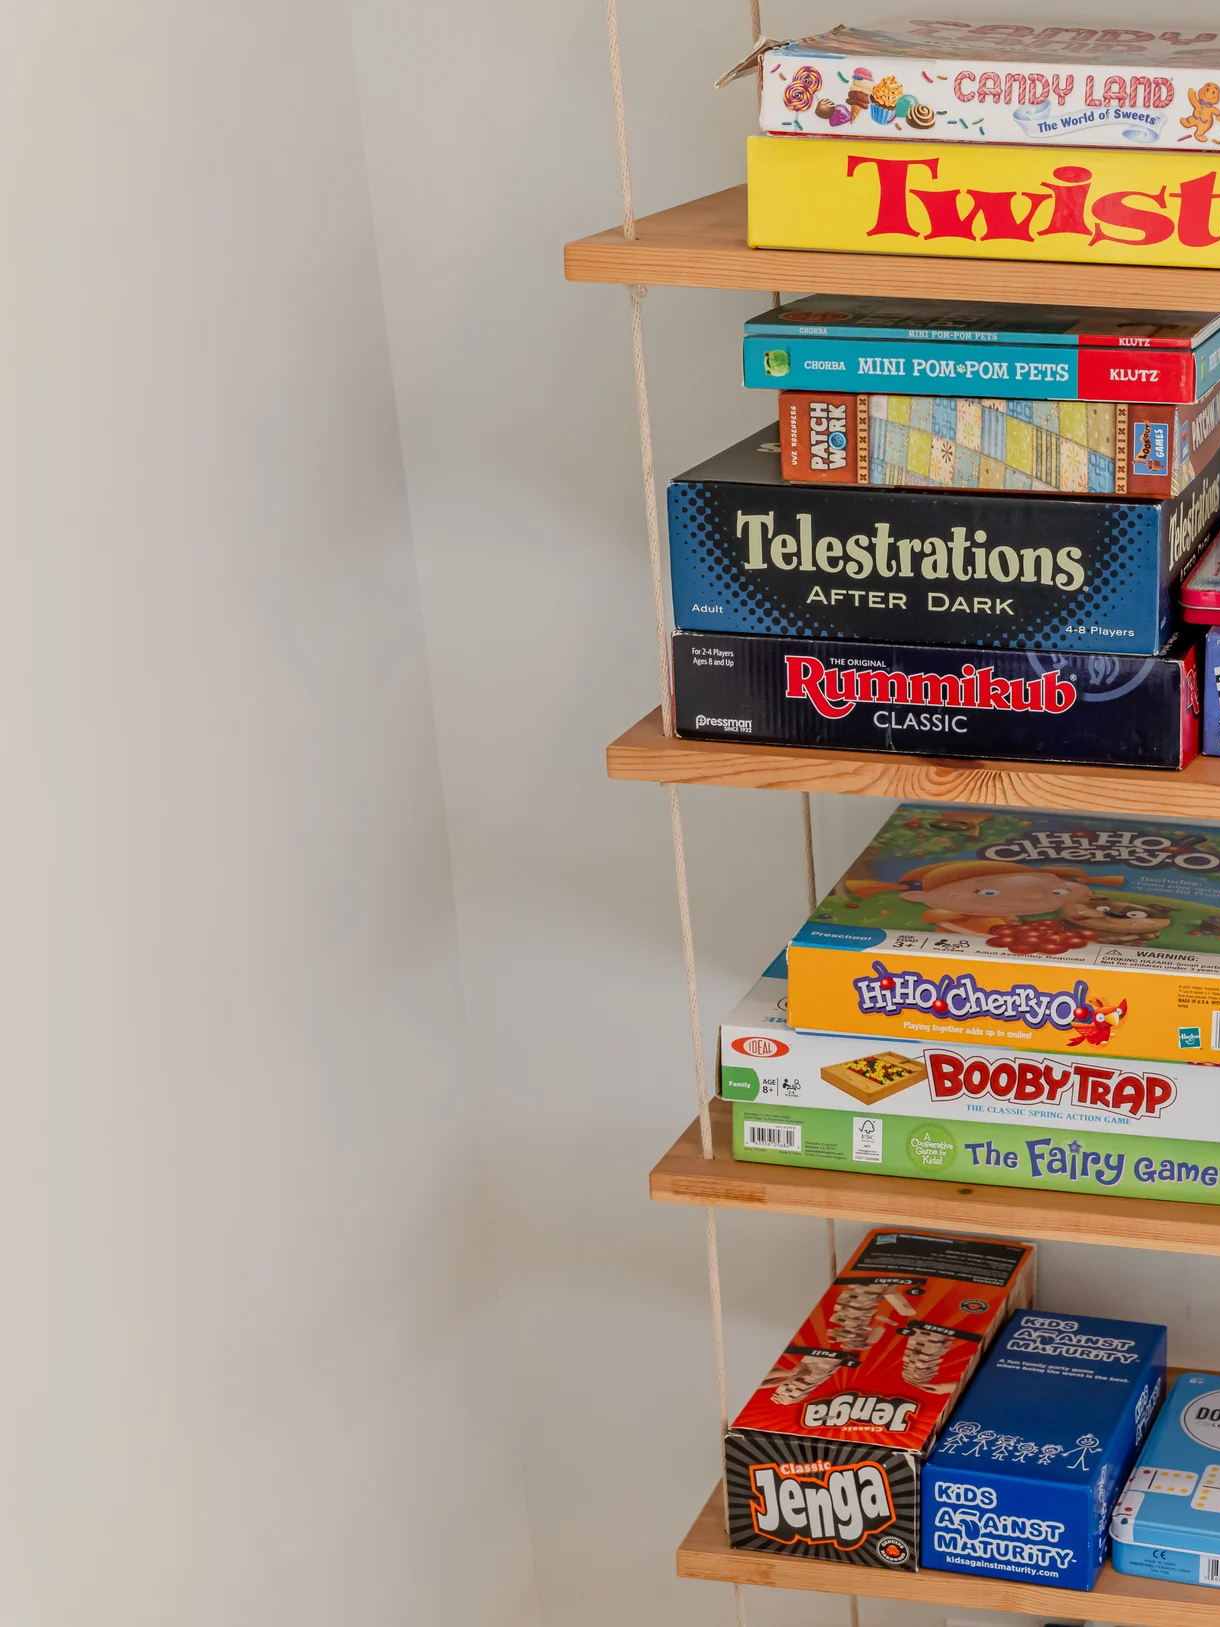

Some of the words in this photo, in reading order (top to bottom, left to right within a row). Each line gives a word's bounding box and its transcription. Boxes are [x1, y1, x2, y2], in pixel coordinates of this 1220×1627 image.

[909, 20, 1217, 45] CANDY
[954, 71, 1074, 106] CANDY
[1085, 75, 1174, 108] LAND
[1037, 121, 1058, 134] The
[1060, 110, 1095, 128] World
[1098, 109, 1110, 120] of
[1114, 109, 1156, 125] Sweets
[908, 330, 928, 338] MINI
[932, 331, 972, 340] POM-POM
[975, 332, 998, 340] PETS
[1119, 338, 1150, 347] KLUTZ
[804, 360, 846, 371] CHORBA
[858, 358, 906, 376] MINI
[1015, 362, 1069, 382] PETS
[1110, 368, 1159, 382] KLUTZ
[790, 406, 798, 448] ROSENBERG
[810, 402, 828, 470] PATCH
[828, 404, 846, 470] WORK
[1156, 428, 1164, 458] GAMES
[1168, 473, 1220, 572] Telestrations
[736, 510, 1085, 592] Telestrations
[806, 585, 907, 610] AFTER
[928, 592, 1015, 616] DARK
[692, 604, 724, 614] Adult
[1065, 626, 1086, 635] 4-8
[1090, 626, 1135, 638] Players
[702, 648, 712, 656] 2-4
[713, 649, 734, 658] Players
[693, 658, 708, 666] Ages
[708, 658, 712, 666] 8
[714, 658, 724, 666] and
[830, 658, 845, 666] THE
[847, 658, 887, 668] ORIGINAL
[785, 655, 1077, 720] Rummikub
[873, 710, 968, 733] CLASSIC
[811, 931, 872, 942] Preschool
[1000, 952, 1043, 960] Assembly
[1136, 951, 1199, 962] WARNING:
[903, 1022, 930, 1032] Playing
[932, 1024, 963, 1034] together
[1007, 1030, 1032, 1039] smiles!
[749, 1040, 772, 1055] IDEAL
[729, 1080, 751, 1088] Family
[762, 1086, 774, 1094] 8+
[929, 1054, 1064, 1102] BOOBY
[1072, 1064, 1172, 1116] TRAP
[966, 1104, 984, 1112] THE
[987, 1106, 1025, 1116] CLASSIC
[1028, 1109, 1063, 1120] SPRING
[1066, 1112, 1100, 1122] ACTION
[1104, 1116, 1132, 1126] GAME
[924, 1133, 932, 1141] A
[910, 1138, 954, 1152] Cooperative
[916, 1148, 938, 1156] Game
[922, 1154, 942, 1166] Kids!
[965, 1140, 1018, 1168] The
[1025, 1138, 1126, 1186] Fairy
[1134, 1158, 1219, 1186] Game
[874, 1278, 914, 1286] Crash!
[923, 1324, 956, 1335] Stack
[812, 1350, 837, 1358] Pull
[804, 1394, 918, 1431] Jenga
[780, 1460, 832, 1476] Classic
[754, 1465, 890, 1540] Jenga
[946, 1555, 1059, 1578] kidsagainstmaturity.com
